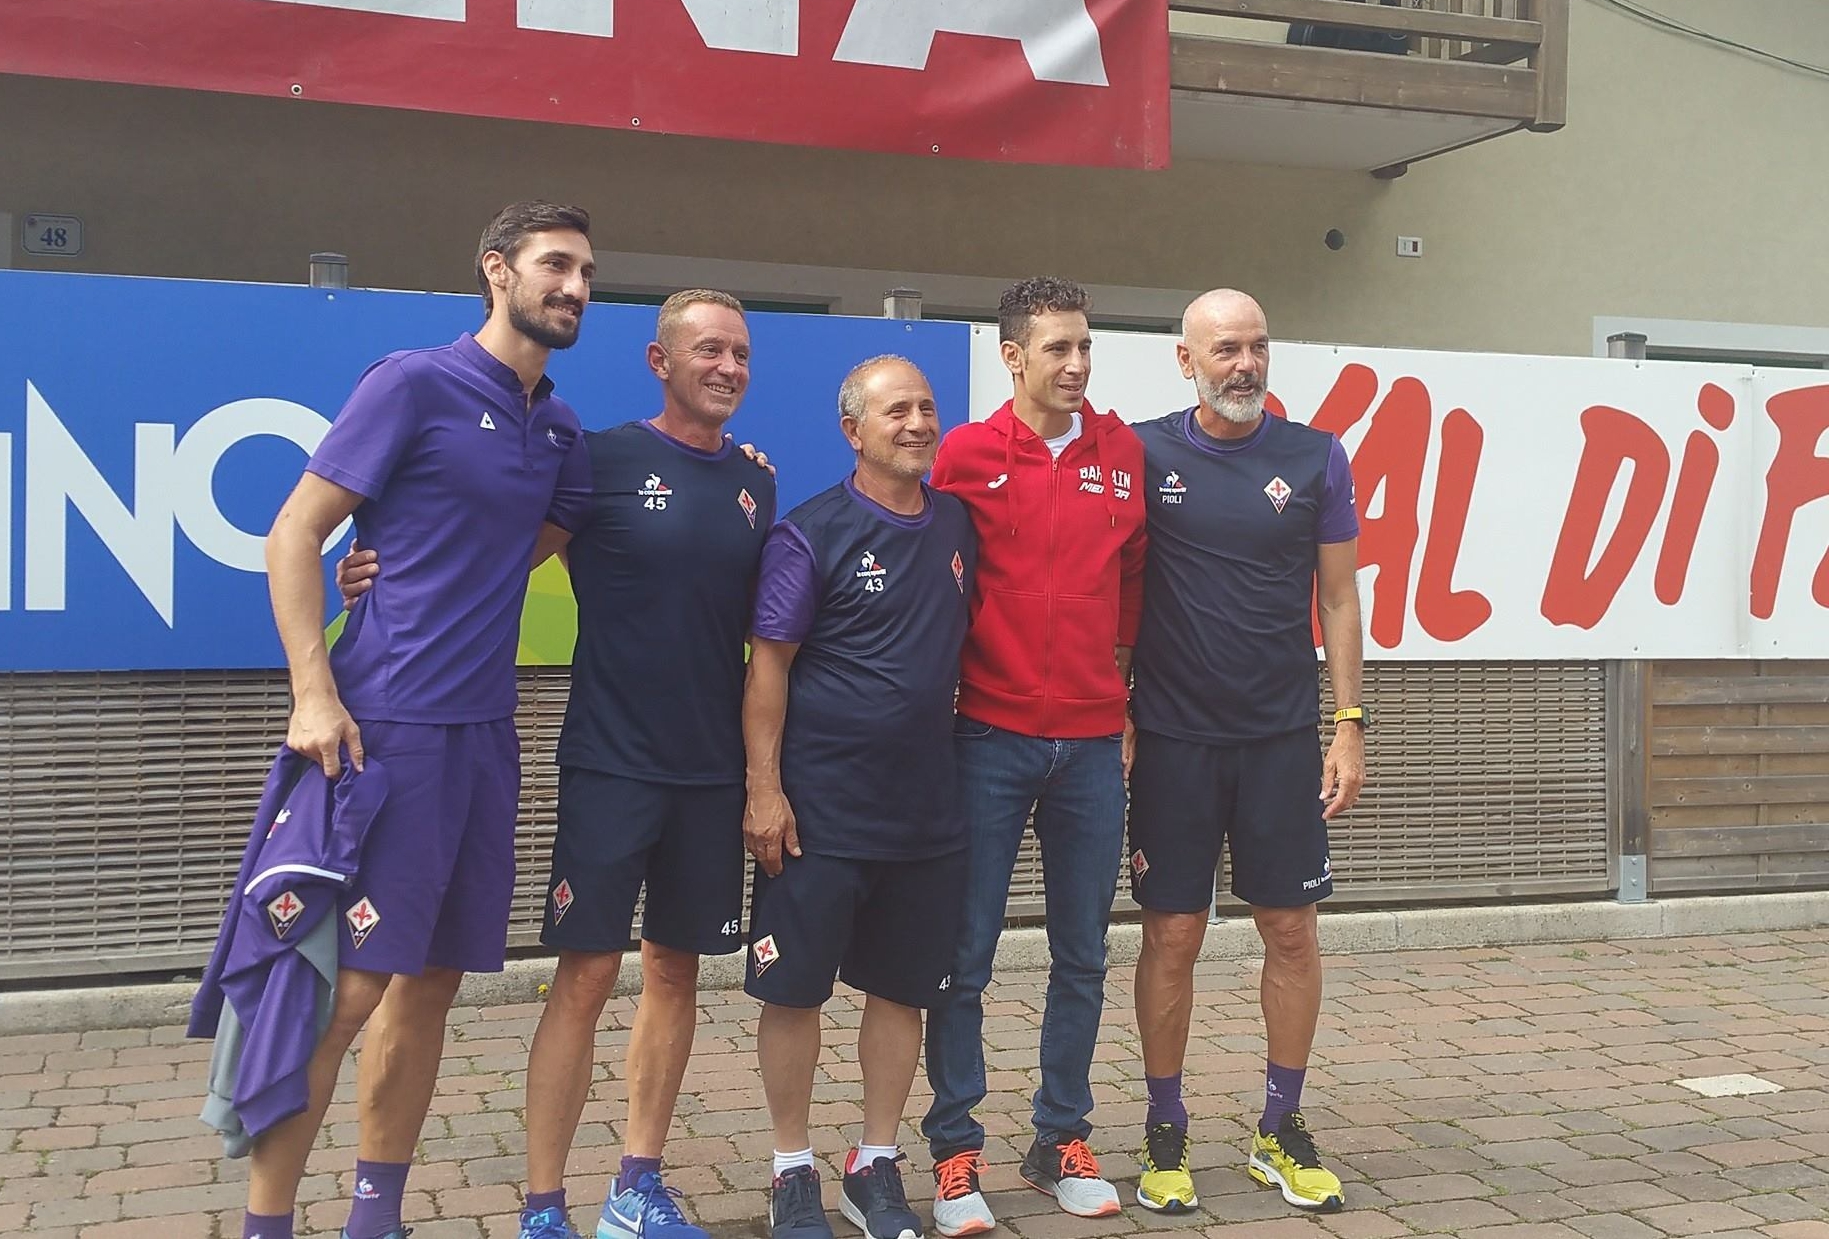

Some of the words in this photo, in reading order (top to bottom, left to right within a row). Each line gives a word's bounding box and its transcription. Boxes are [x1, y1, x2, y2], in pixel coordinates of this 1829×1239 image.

[40, 227, 67, 247] 48
[643, 496, 667, 510] 45
[1162, 495, 1182, 504] PIOLI
[864, 577, 884, 593] 43
[1303, 877, 1321, 890] PIOLI
[721, 919, 739, 936] 45
